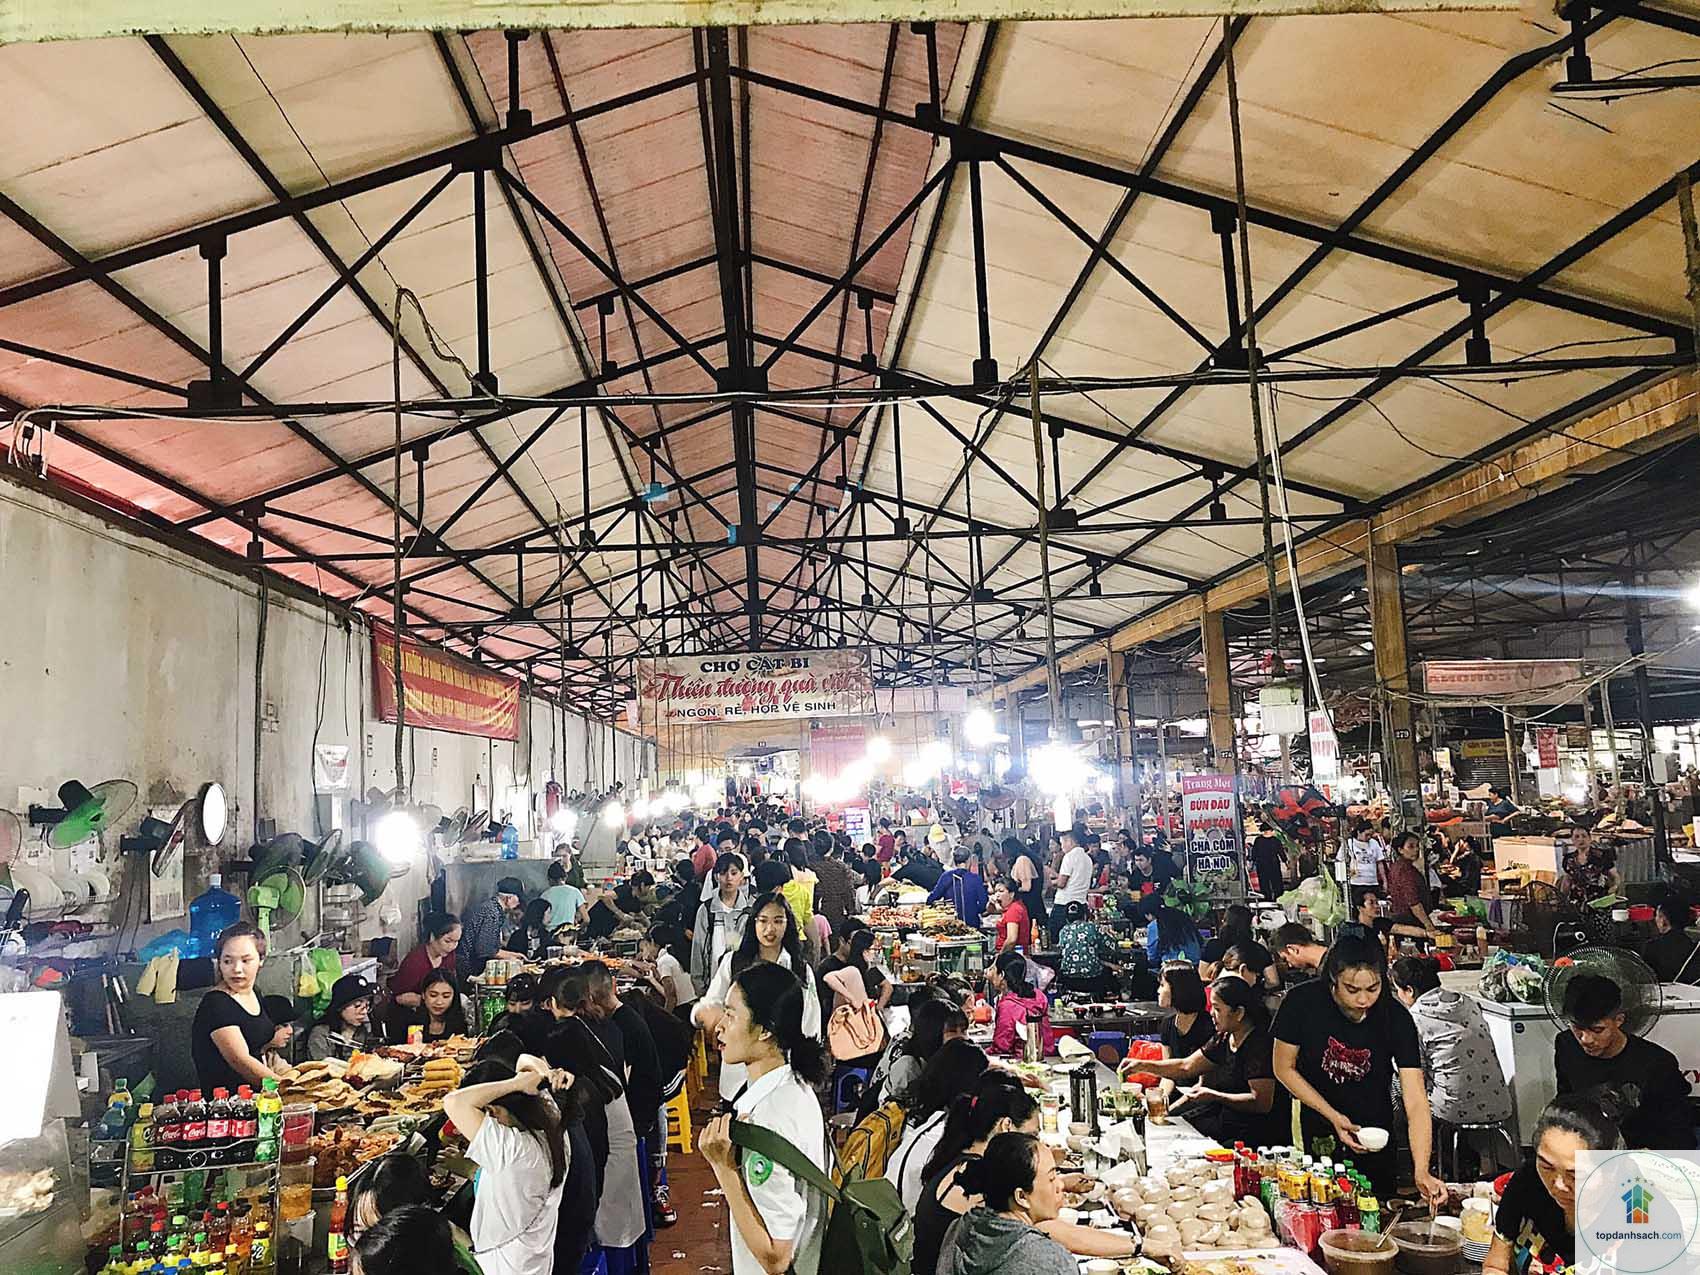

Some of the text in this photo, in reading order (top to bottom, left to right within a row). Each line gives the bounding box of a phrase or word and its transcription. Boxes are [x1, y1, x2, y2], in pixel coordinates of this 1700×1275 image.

[700, 659, 740, 675] CHỢ
[790, 658, 809, 669] BI
[655, 673, 713, 702] Thiên
[714, 673, 777, 704] đường
[804, 702, 836, 712] SINH
[1184, 780, 1212, 790] Trang
[1190, 796, 1230, 813] BÚN ĐẬU
[1198, 855, 1230, 871] HÀ NỘI
